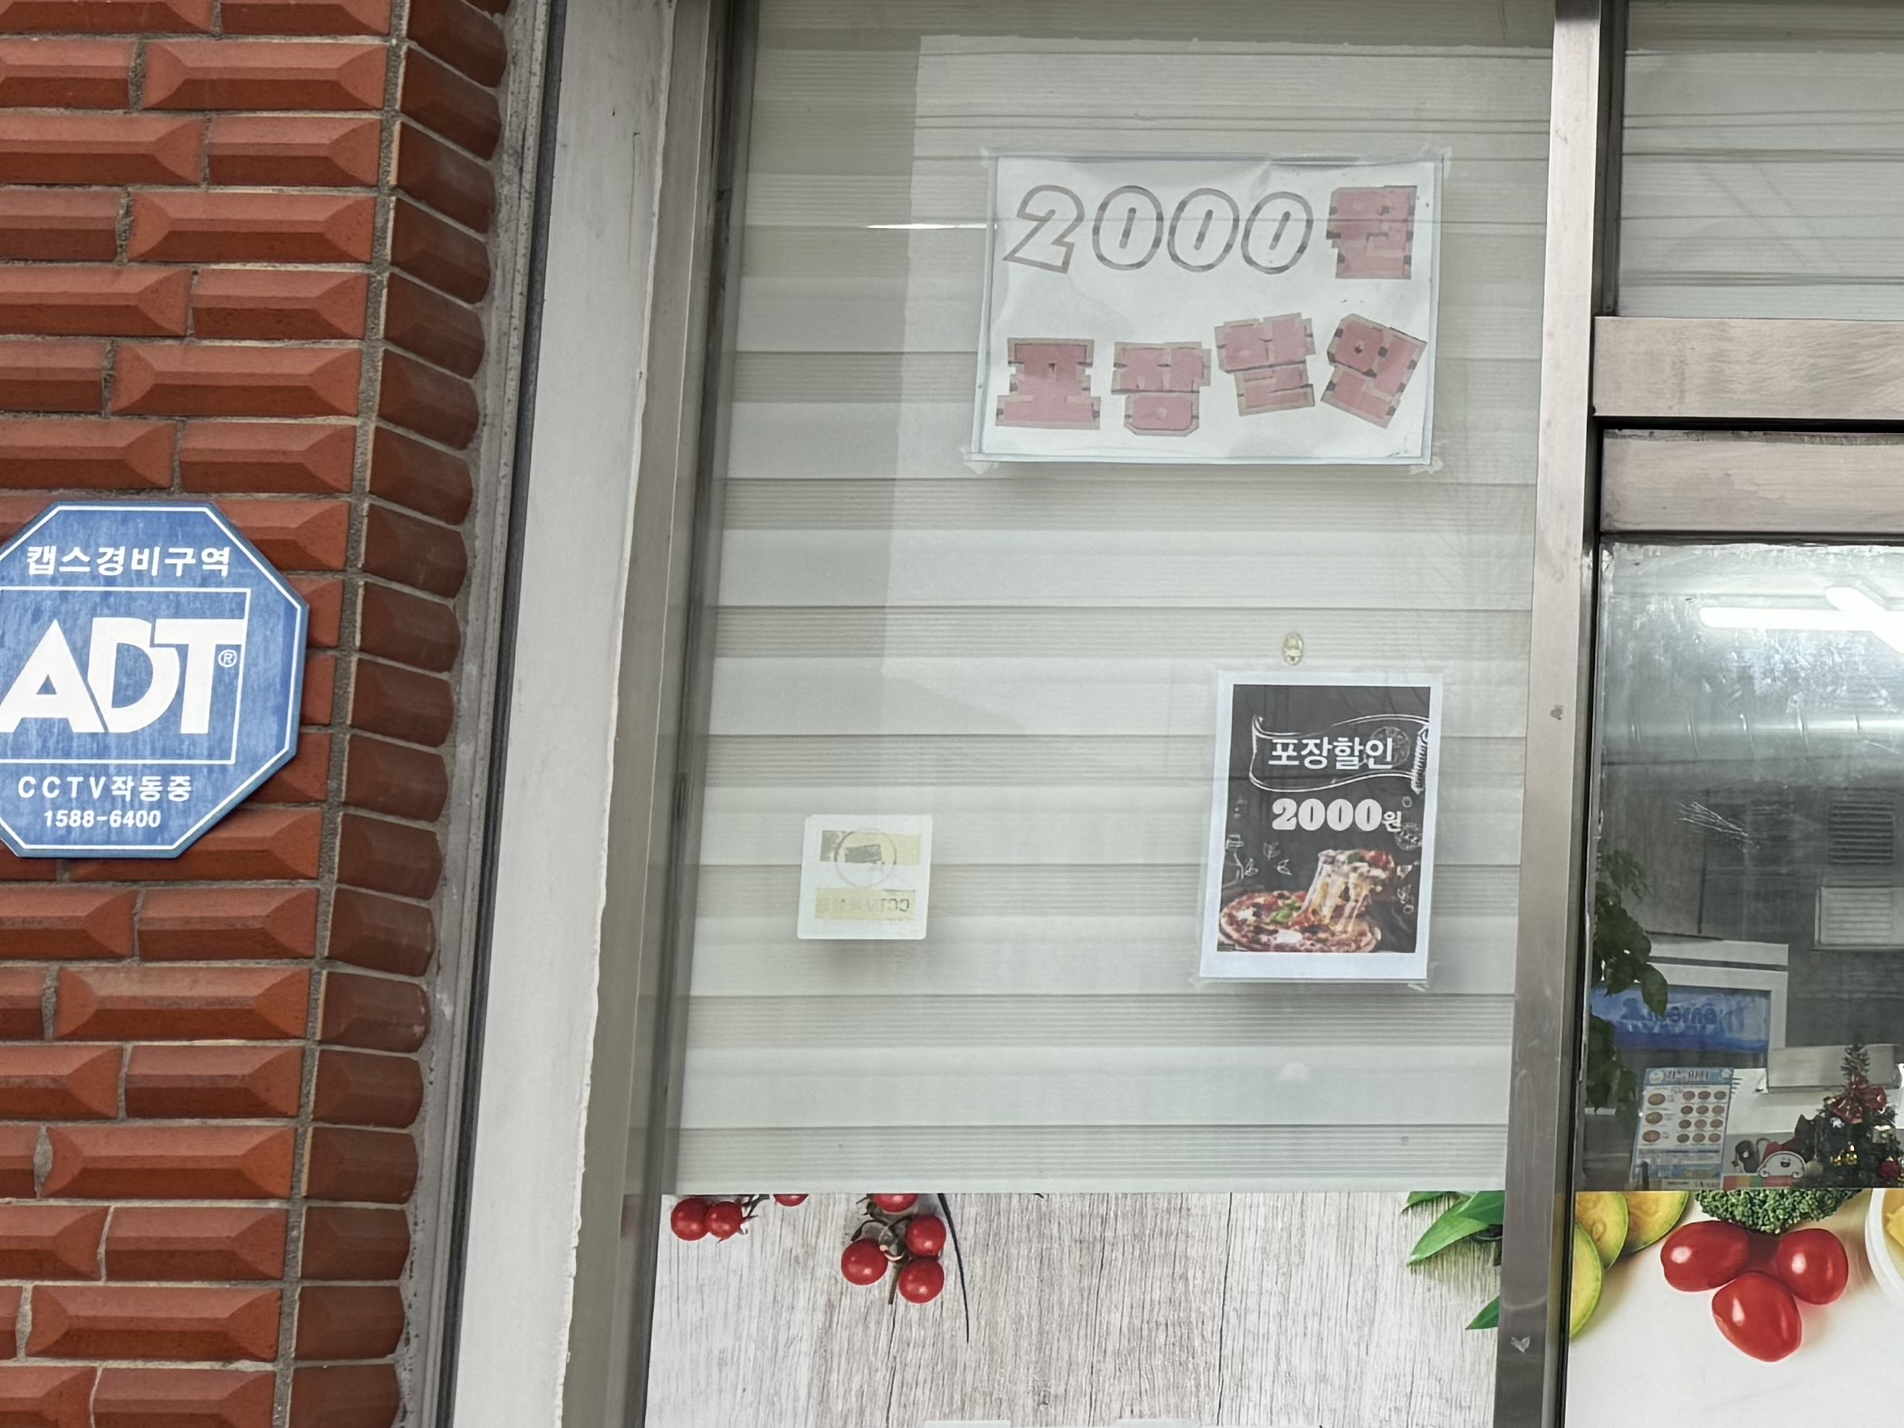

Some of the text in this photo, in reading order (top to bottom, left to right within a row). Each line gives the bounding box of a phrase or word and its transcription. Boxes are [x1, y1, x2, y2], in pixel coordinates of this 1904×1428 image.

[26, 545, 231, 577] 캡스경비구역
[0, 617, 246, 734] ADT
[1268, 736, 1393, 770] 포장할인
[17, 775, 192, 803] CCTV작동중
[43, 809, 162, 829] 1588-6400
[1271, 797, 1402, 832] 2000원
